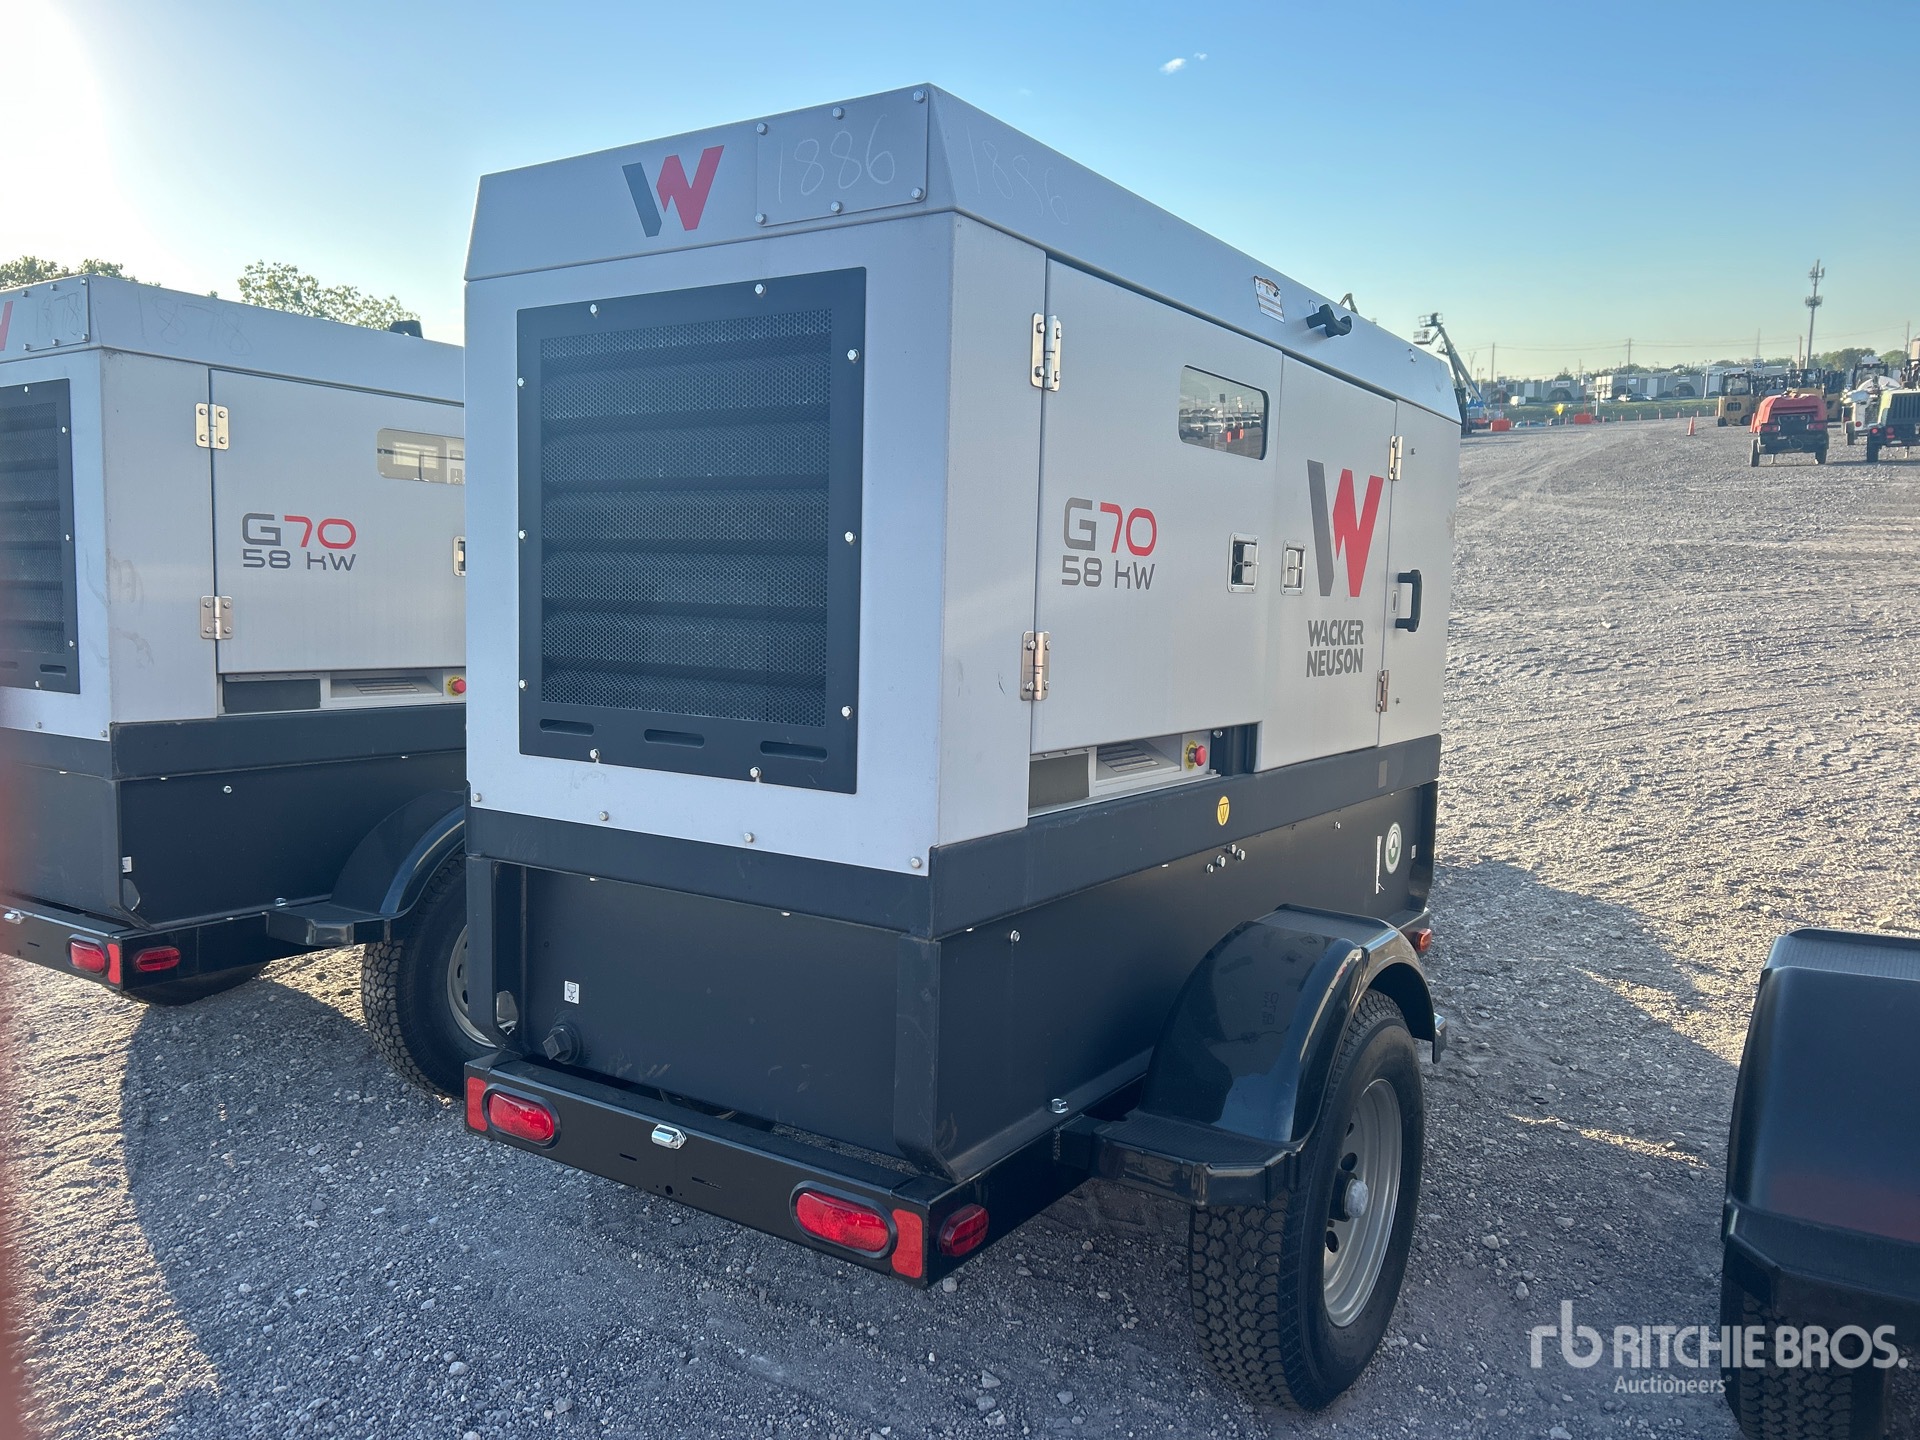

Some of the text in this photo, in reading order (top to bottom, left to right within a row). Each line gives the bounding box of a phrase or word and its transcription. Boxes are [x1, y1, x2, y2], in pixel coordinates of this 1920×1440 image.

[776, 114, 895, 204] 1886
[242, 513, 357, 549] G70
[1064, 497, 1157, 556] G70
[243, 549, 357, 572] 58 kW
[1062, 554, 1155, 590] 58 kW
[1307, 619, 1364, 647] WACKER
[1306, 648, 1363, 678] NEUSON
